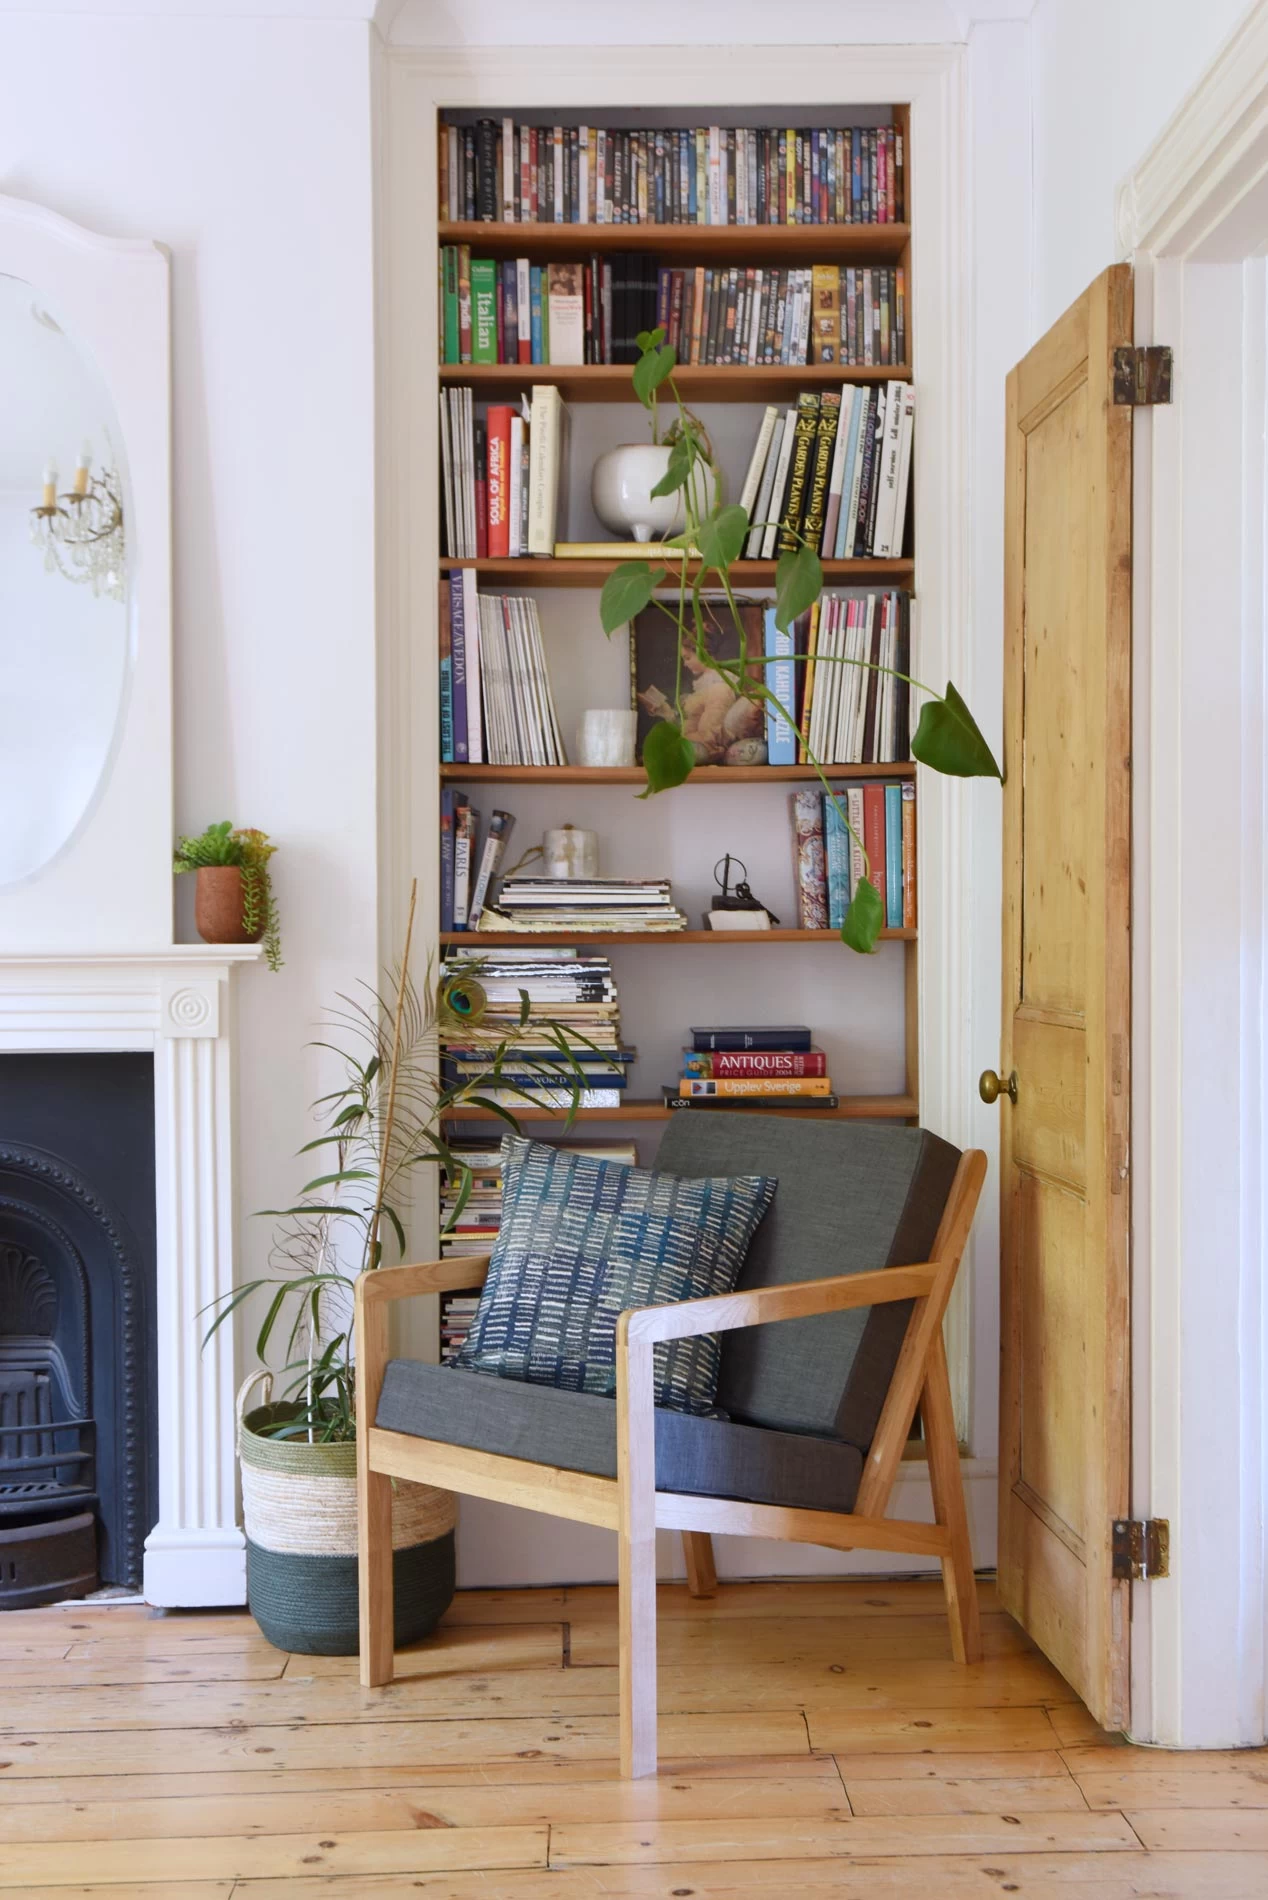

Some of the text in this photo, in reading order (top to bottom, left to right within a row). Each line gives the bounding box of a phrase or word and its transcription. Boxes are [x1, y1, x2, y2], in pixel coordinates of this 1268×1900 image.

[477, 292, 495, 350] Italian
[863, 419, 875, 458] LONDON
[793, 437, 811, 477] GARDEN
[490, 436, 500, 526] SOUL OF AFRICA
[810, 437, 832, 515] GARDEN PLANTS
[788, 477, 805, 515] PLANTS
[857, 498, 868, 524] BOOK
[441, 694, 450, 708] THE
[776, 665, 791, 702] KAHLO
[442, 710, 451, 718] OF
[442, 740, 451, 754] THE
[851, 799, 861, 826] LITTLE
[456, 842, 468, 878] PARIS
[719, 1055, 793, 1069] ANTIQUES
[724, 1081, 802, 1094] Upplev Sverige
